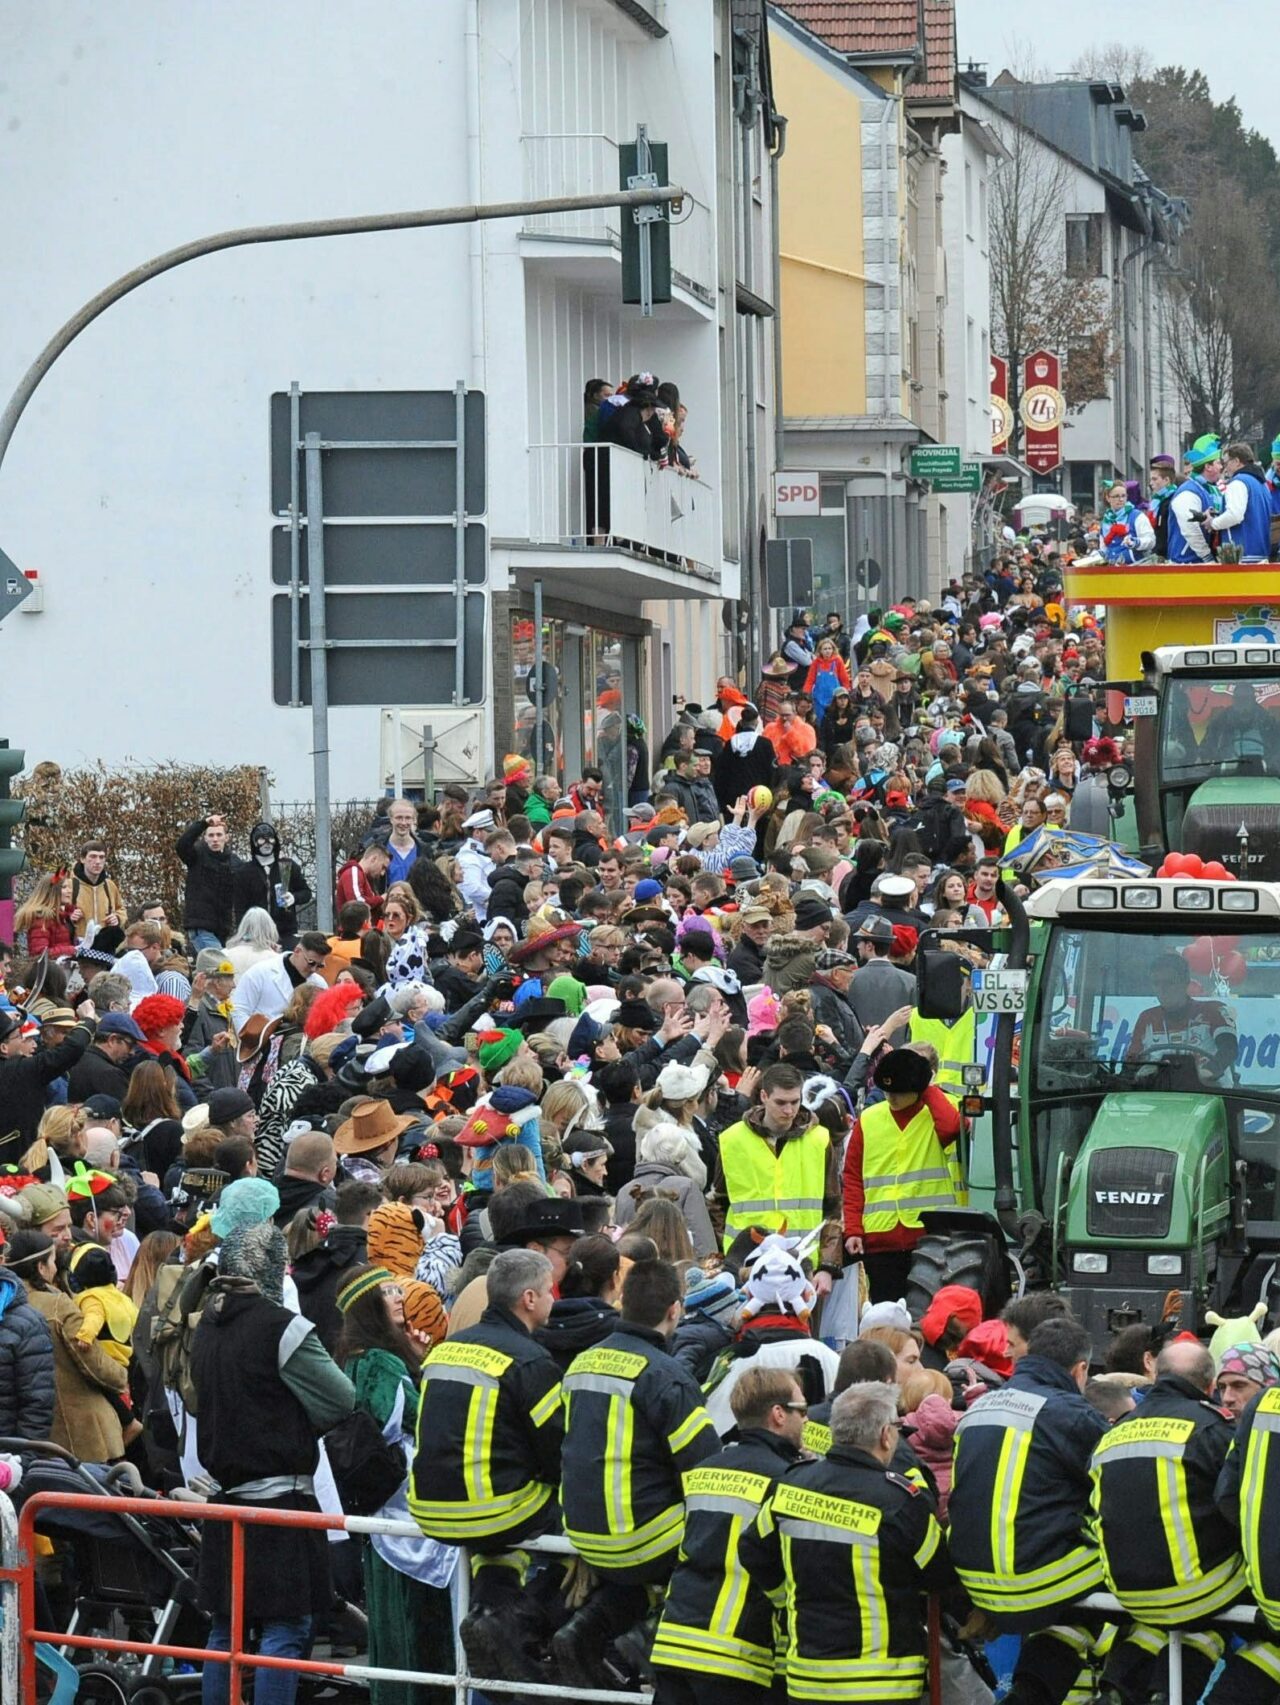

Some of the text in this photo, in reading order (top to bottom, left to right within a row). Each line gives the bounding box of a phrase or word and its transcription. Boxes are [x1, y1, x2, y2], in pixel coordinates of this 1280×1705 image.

[912, 449, 958, 457] PROVINZIAL
[777, 485, 818, 502] SPD
[984, 973, 1007, 990] GL
[974, 992, 1024, 1009] VS 63
[1095, 1191, 1165, 1205] FENDT
[779, 1487, 878, 1521] FEUERWEHR
[785, 1502, 861, 1528] LEICHLINGEN
